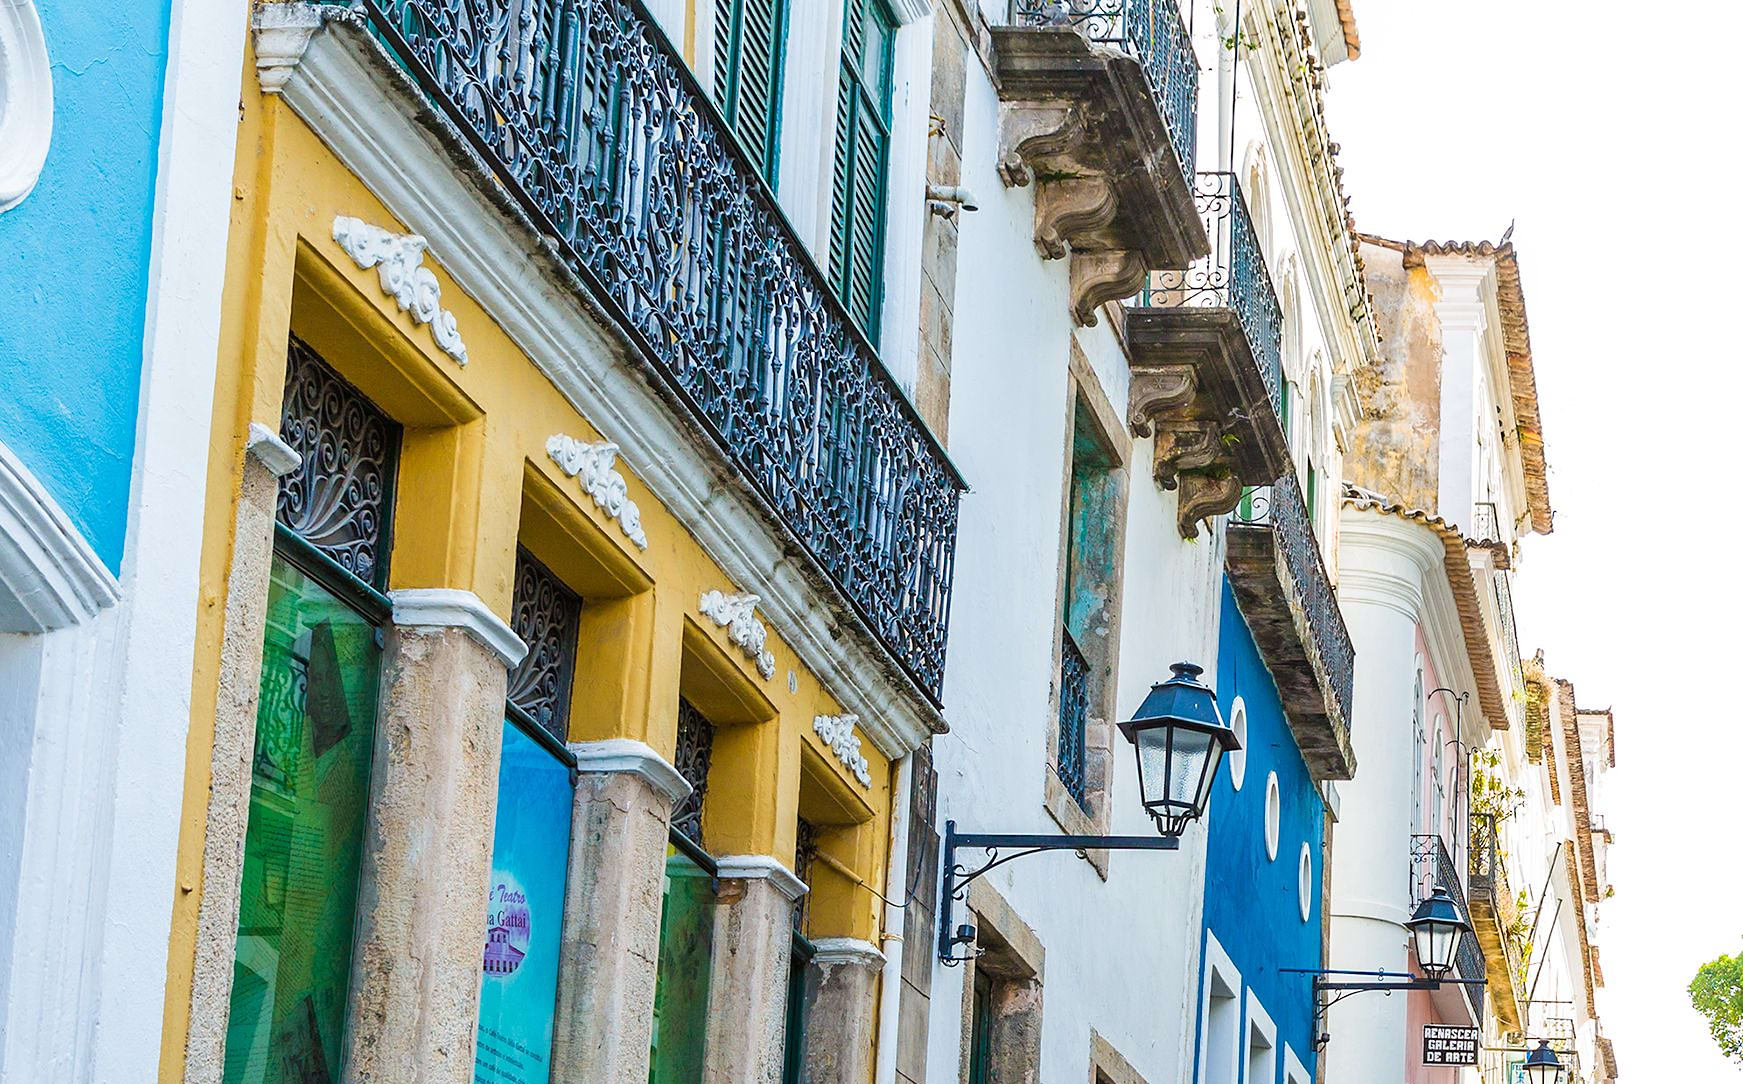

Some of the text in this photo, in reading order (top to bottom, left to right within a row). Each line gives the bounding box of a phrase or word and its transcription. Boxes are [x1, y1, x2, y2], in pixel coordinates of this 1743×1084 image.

[497, 884, 526, 904] Teatro
[498, 910, 526, 928] Gattai
[1424, 1027, 1478, 1040] RENASCER
[1428, 1040, 1474, 1051] GALERIA
[1426, 1052, 1475, 1063] DE ARTE
